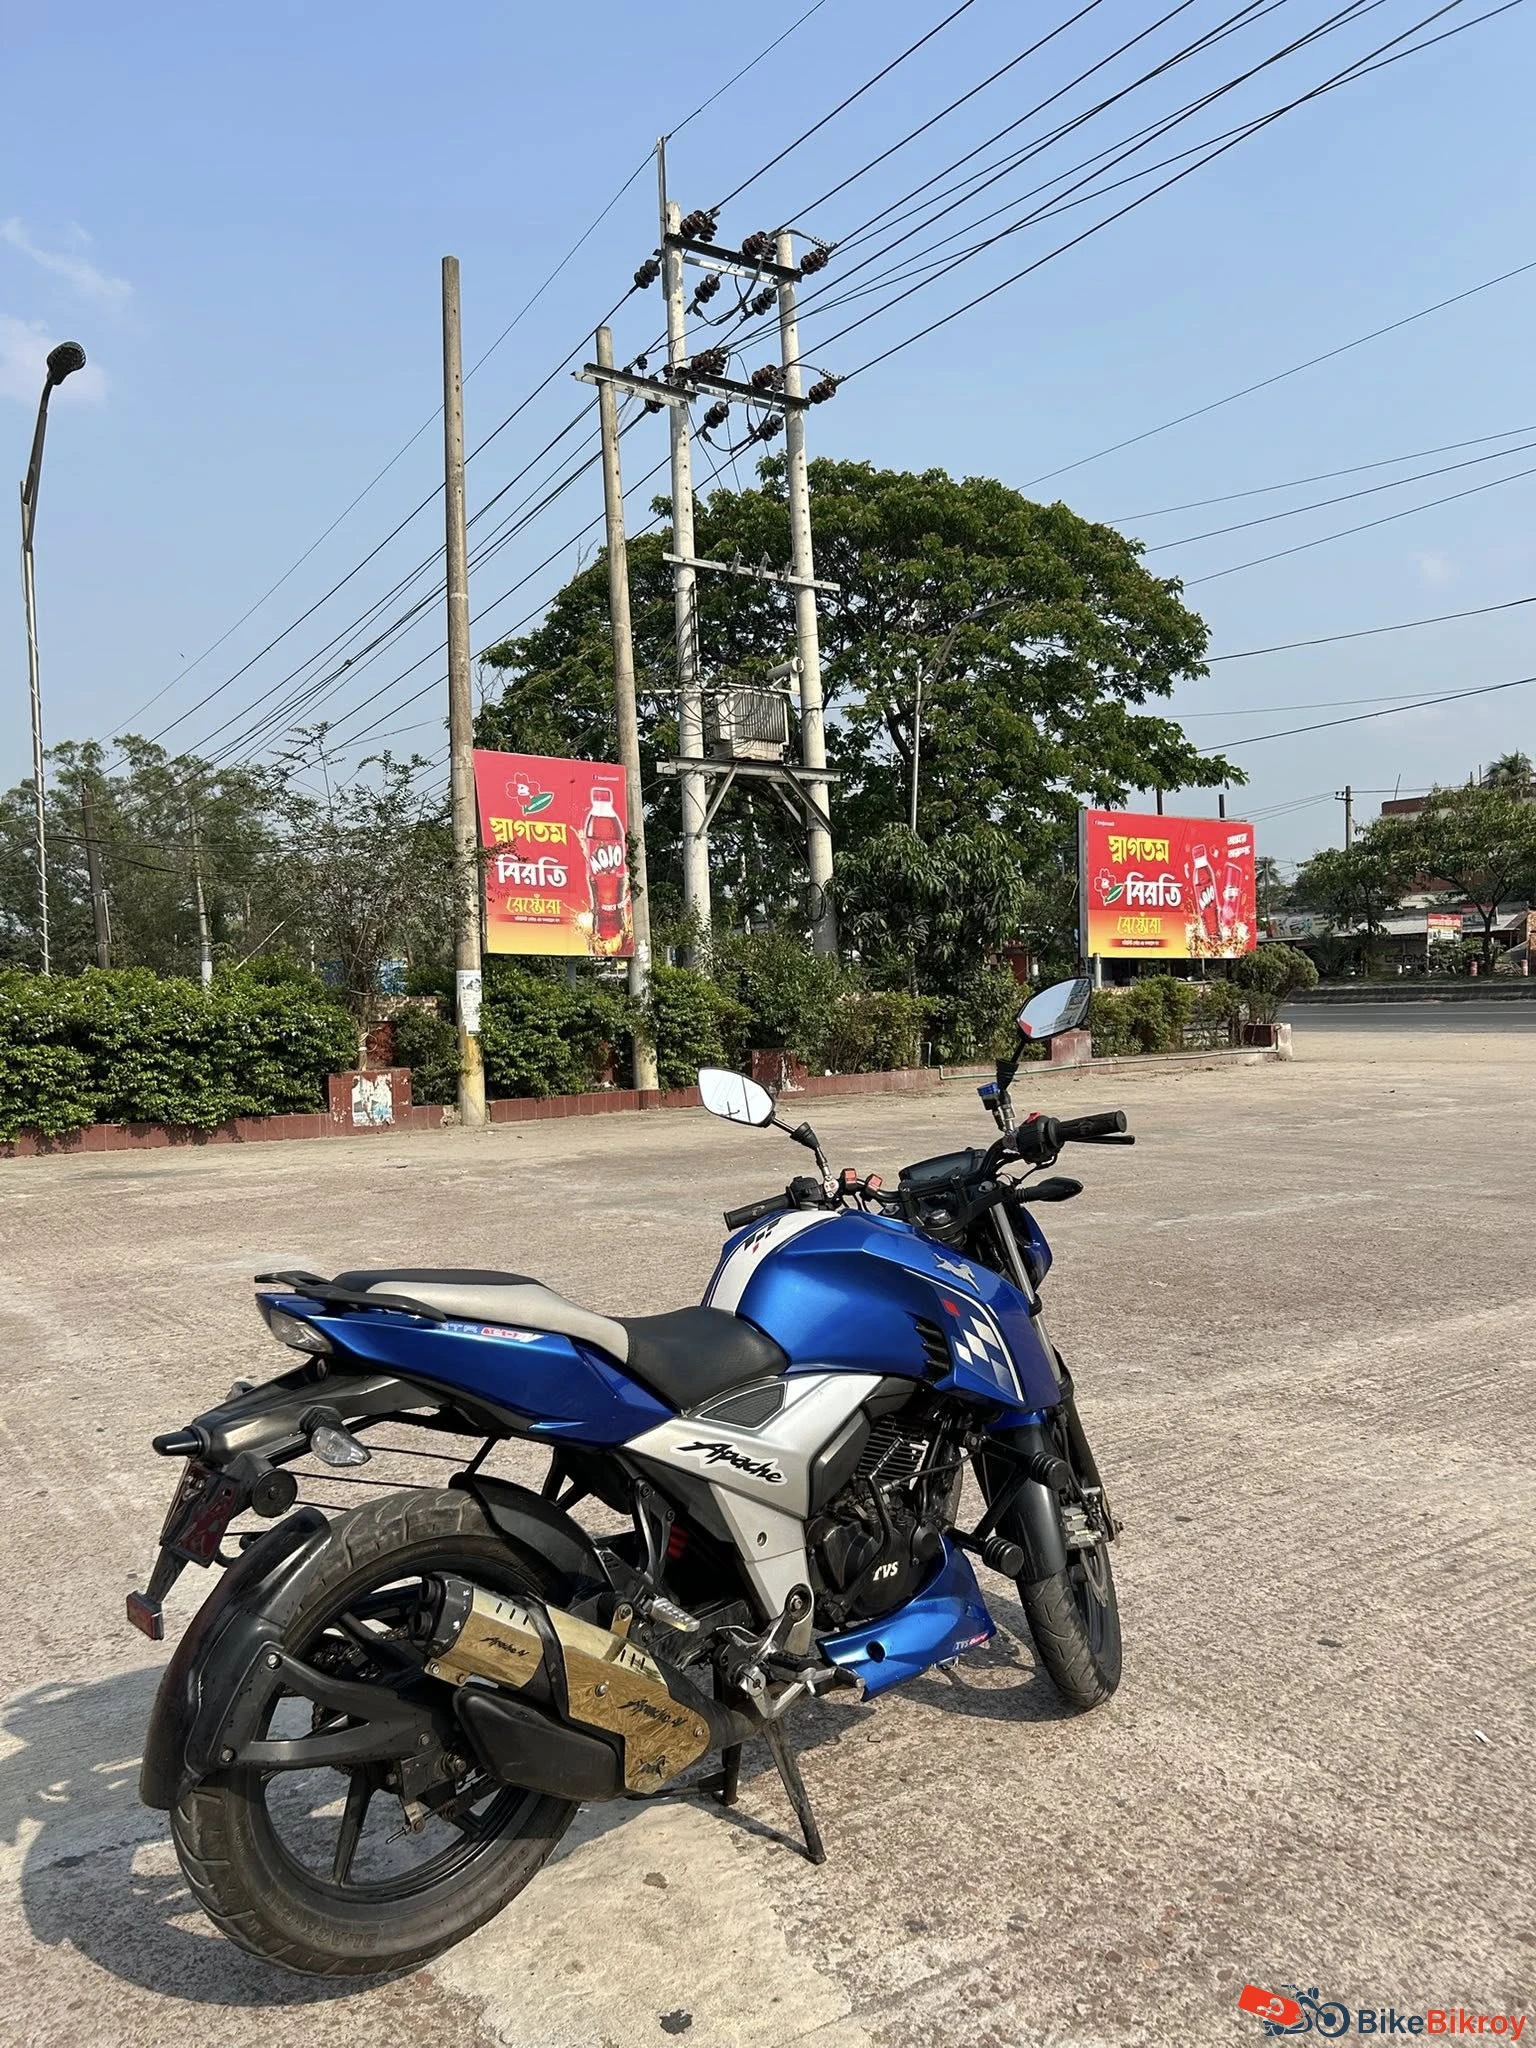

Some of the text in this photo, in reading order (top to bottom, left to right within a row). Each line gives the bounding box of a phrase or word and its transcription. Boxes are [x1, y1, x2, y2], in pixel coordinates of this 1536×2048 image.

[489, 816, 568, 846] স্বাগতম
[589, 845, 623, 876] MOJO
[1107, 835, 1170, 865] স্বাগতম
[495, 853, 569, 887] বিরতি
[1124, 871, 1183, 907] বিরতি
[678, 1440, 784, 1484] Apache
[873, 1560, 899, 1581] TVS
